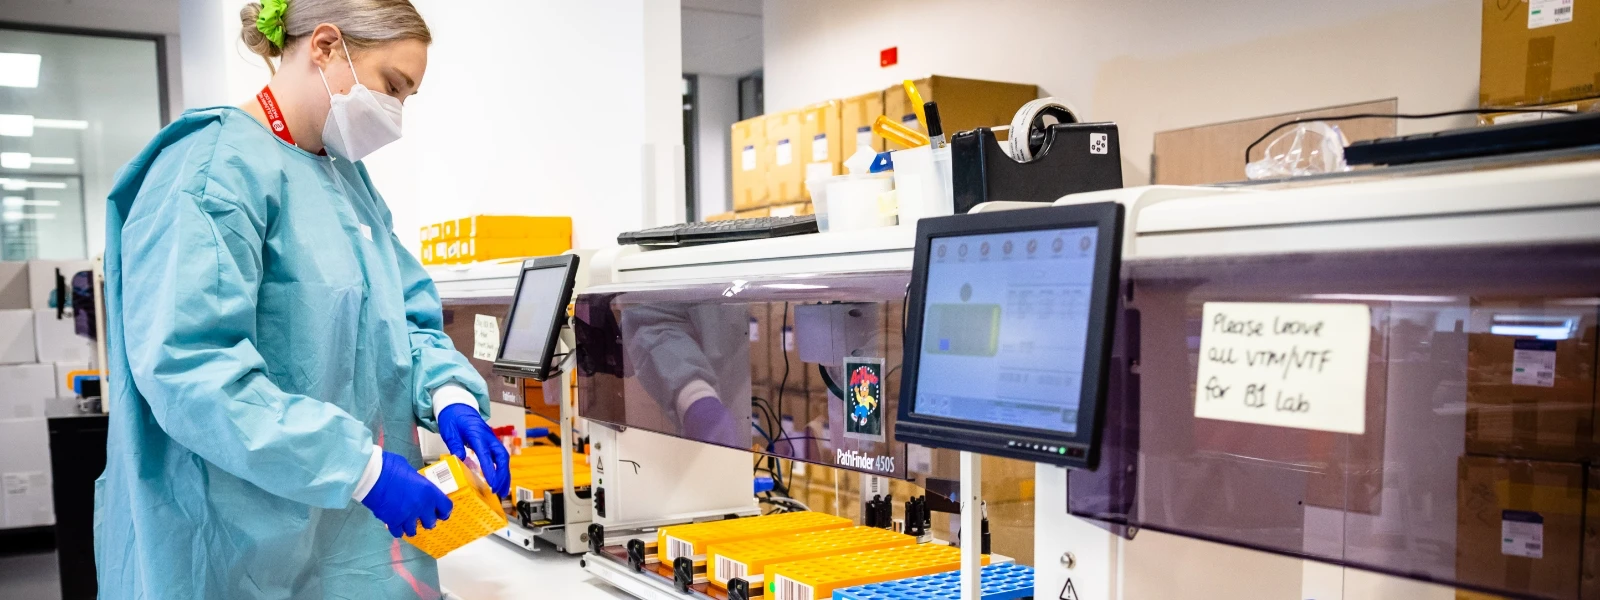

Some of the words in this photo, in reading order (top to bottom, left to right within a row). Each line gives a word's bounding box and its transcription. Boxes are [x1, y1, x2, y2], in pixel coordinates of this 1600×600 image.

[1212, 312, 1264, 337] Please
[1208, 347, 1238, 364] all
[1246, 345, 1334, 381] VTM/VTF
[1204, 376, 1230, 401] for
[1243, 383, 1267, 408] B1
[836, 448, 875, 470] PathFinder
[875, 455, 895, 473] 450S
